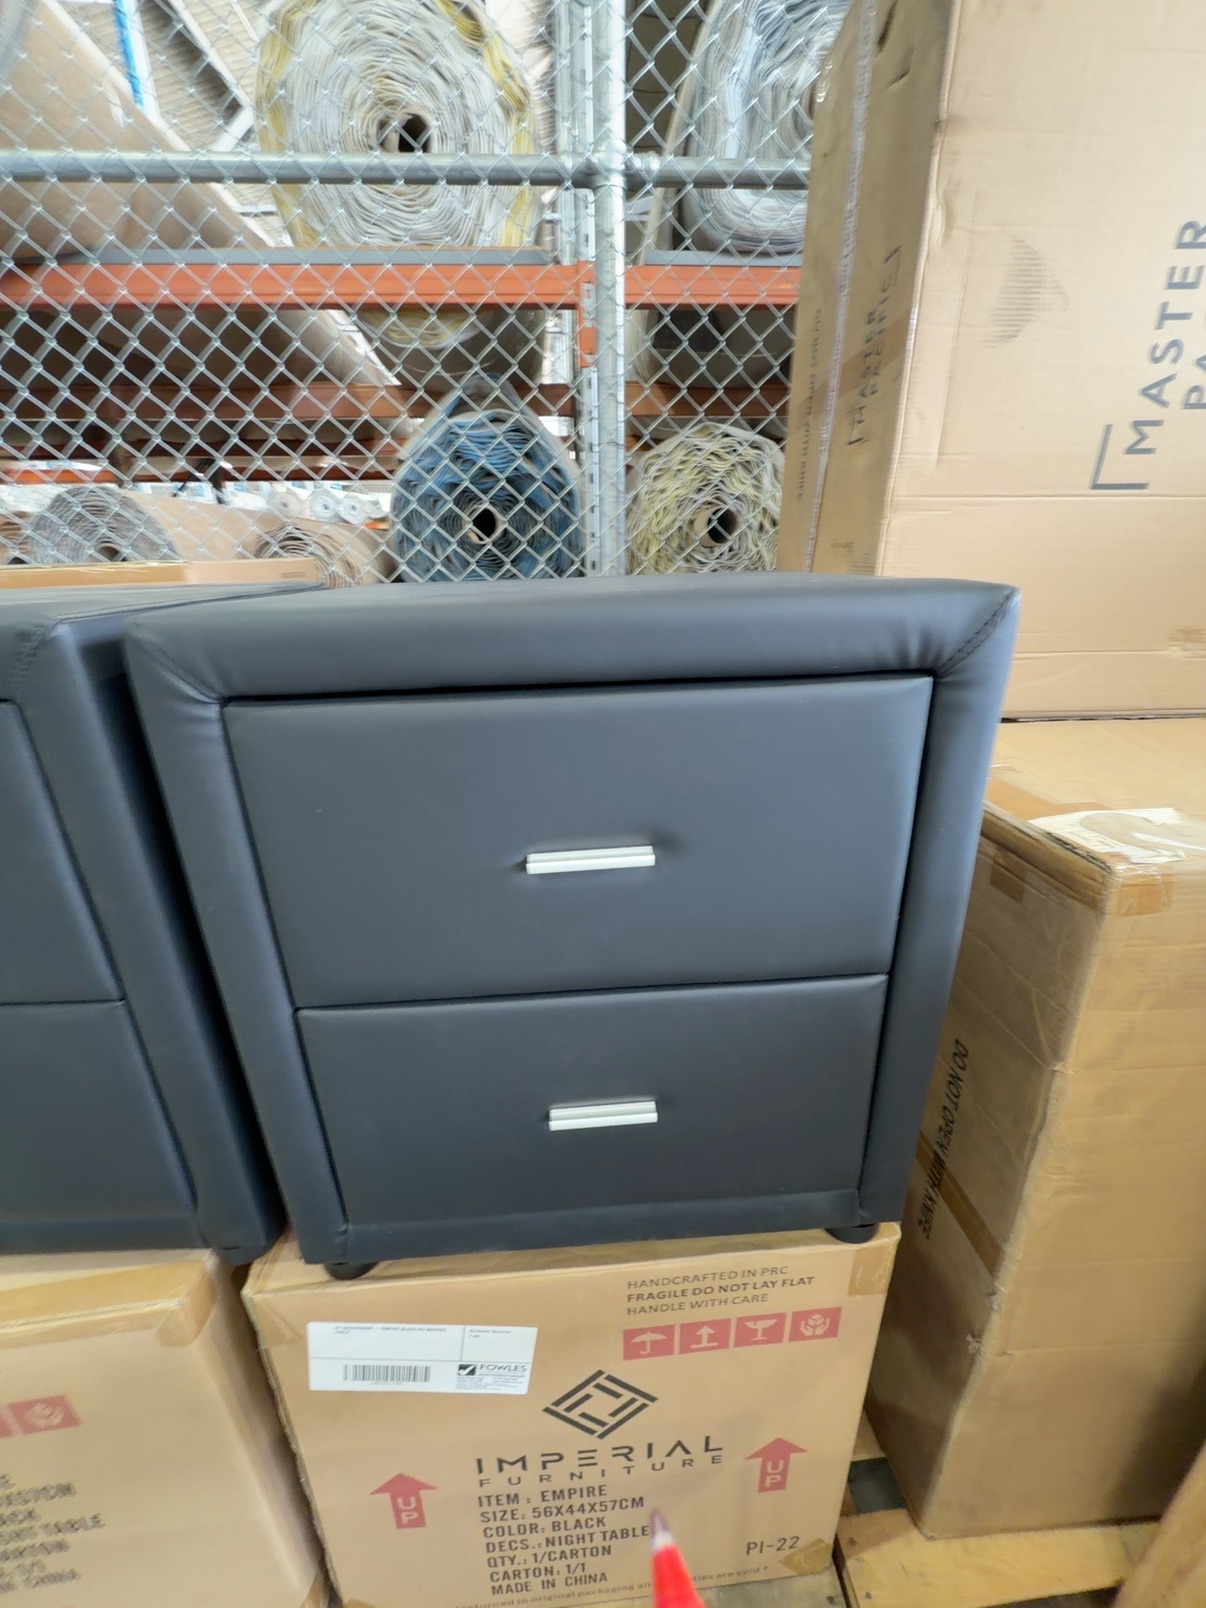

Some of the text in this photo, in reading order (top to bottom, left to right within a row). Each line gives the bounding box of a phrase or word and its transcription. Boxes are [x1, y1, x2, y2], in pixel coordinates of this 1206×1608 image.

[1123, 220, 1206, 455] MASTER
[917, 1038, 969, 1240] DO NOT OPEN WITH KNIFE
[627, 1265, 789, 1290] HANDCRAFTED IN PRC
[627, 1275, 816, 1303] FRAGILE DO NOT LAY FLAT
[627, 1293, 769, 1316] HANDLE WITH CARE
[479, 1362, 528, 1374] FOWLES
[476, 1435, 724, 1475] IMPERIAL
[479, 1454, 723, 1488] FURNITURE
[764, 1460, 785, 1488] UP
[540, 1484, 608, 1503] EMPIRE
[397, 1496, 419, 1525] UP
[480, 1496, 645, 1523] SIZE: 56X44X57CM
[483, 1516, 607, 1539] COLOR: BLACK
[600, 1525, 650, 1542] TABLE
[487, 1545, 612, 1569] QTY.: 1/CARTON
[490, 1562, 586, 1583] CARTON: 1/1
[491, 1572, 608, 1596] MADE IN CHINA
[530, 1591, 575, 1604] original
[578, 1584, 635, 1600] packaging
